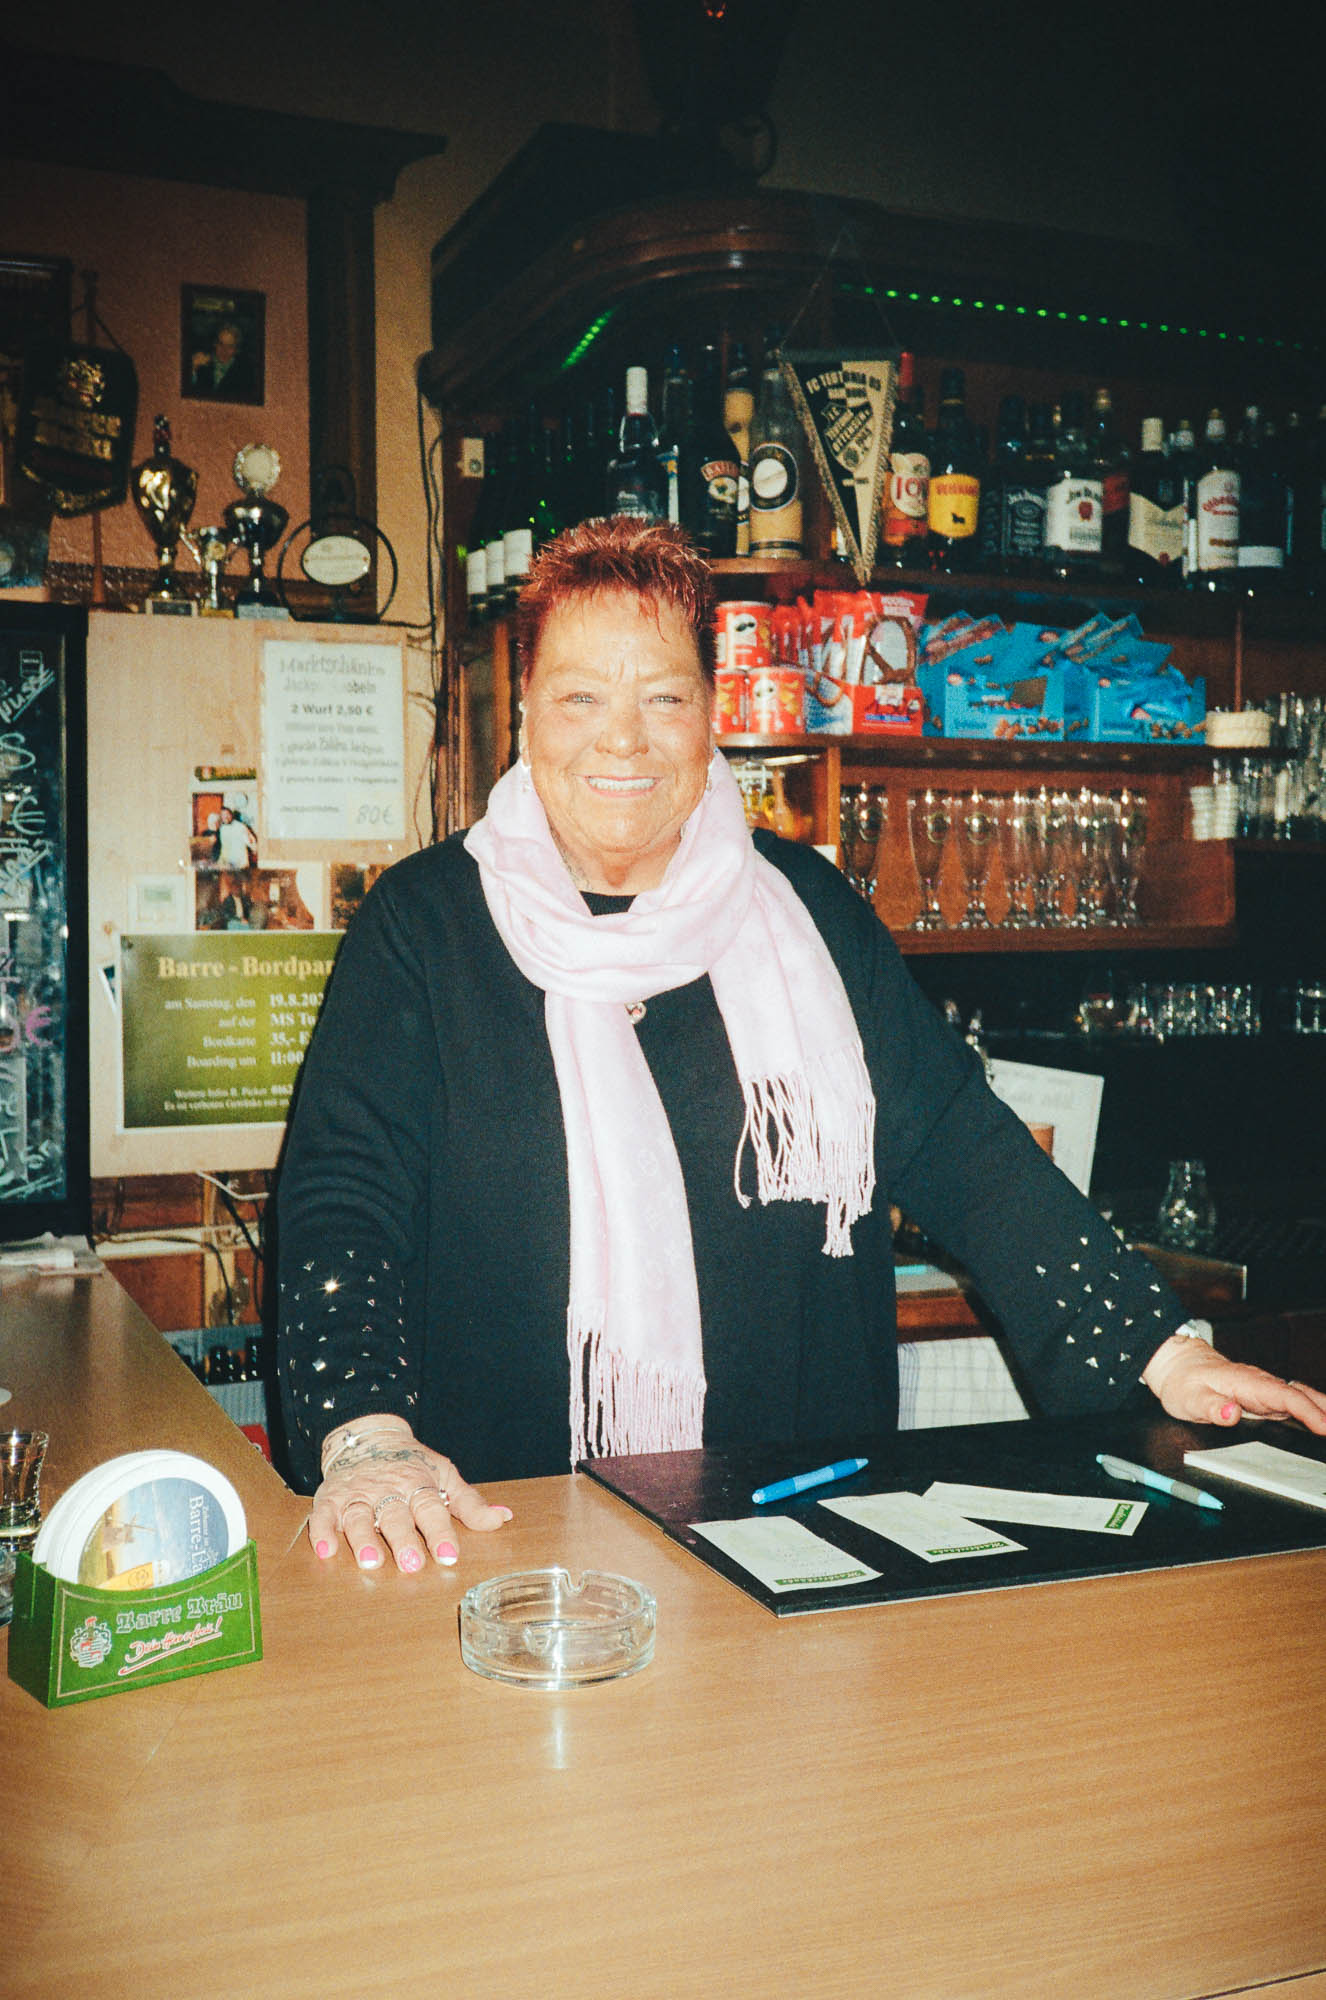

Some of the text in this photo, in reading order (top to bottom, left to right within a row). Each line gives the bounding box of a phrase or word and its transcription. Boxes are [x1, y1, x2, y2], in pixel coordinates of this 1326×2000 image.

[303, 704, 332, 715] Wurf
[158, 956, 225, 978] Barre
[241, 956, 334, 981] Bordpar
[236, 997, 256, 1008] den
[218, 1016, 236, 1028] auf
[238, 1017, 256, 1028] der
[270, 1012, 294, 1026] MS
[203, 1035, 256, 1048] Bordkarte
[299, 1031, 310, 1045] E
[187, 1051, 304, 1070] Boarding um 11:00
[189, 1495, 205, 1574] Barre-La
[187, 1592, 244, 1620] Bräu
